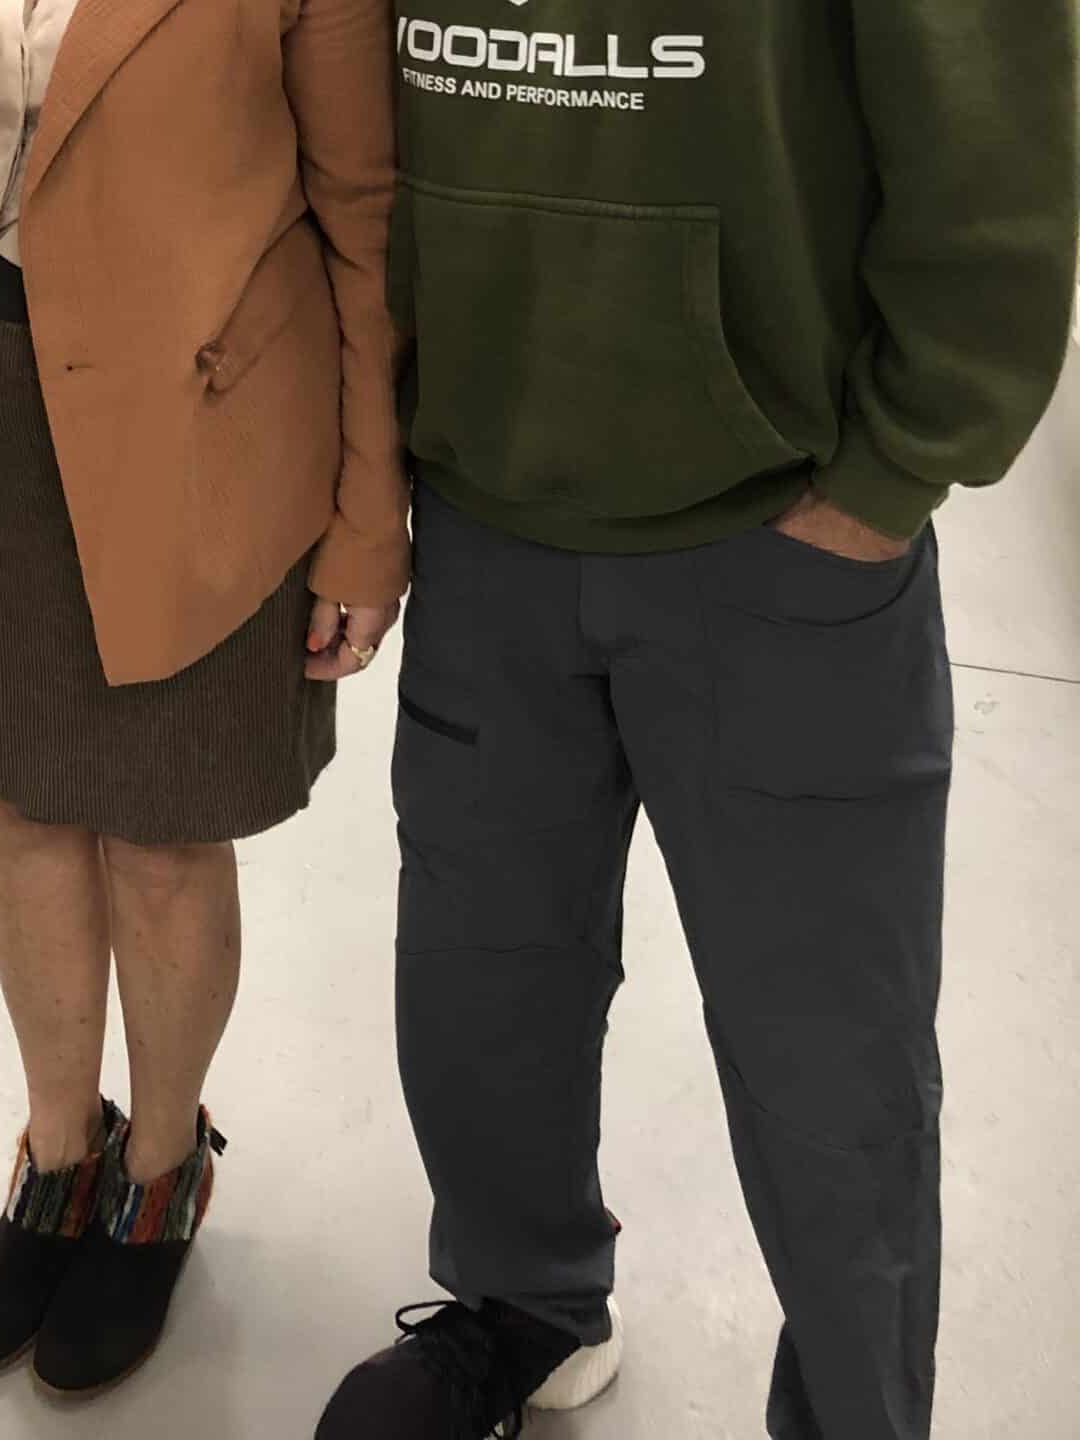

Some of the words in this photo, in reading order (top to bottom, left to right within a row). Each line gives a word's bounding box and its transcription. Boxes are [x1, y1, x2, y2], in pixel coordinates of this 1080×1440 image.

[402, 67, 457, 95] FITNESS
[461, 79, 501, 101] AND
[506, 84, 645, 111] PERFORMANCE
